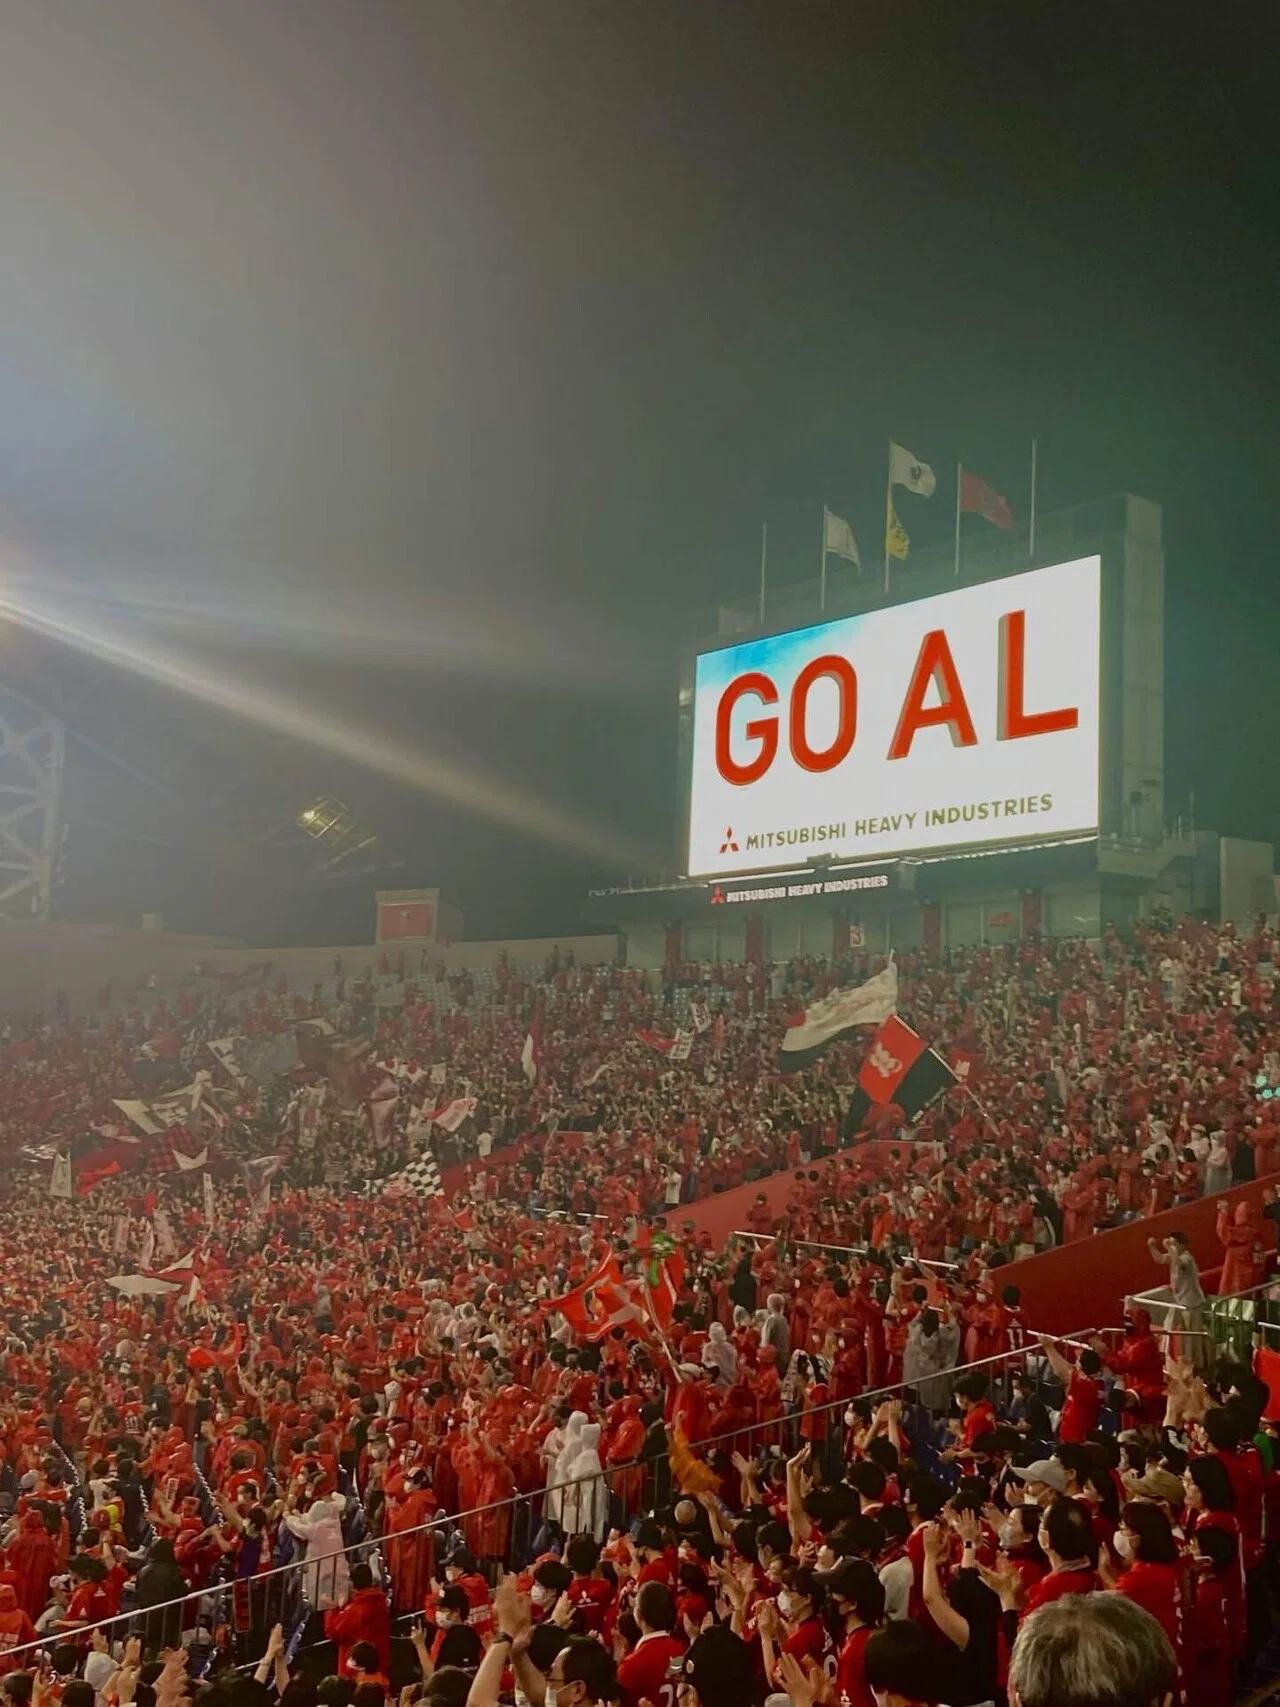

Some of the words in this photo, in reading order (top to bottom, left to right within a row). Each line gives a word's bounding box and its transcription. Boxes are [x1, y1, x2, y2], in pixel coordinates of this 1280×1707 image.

[714, 608, 1079, 786] GOAL
[746, 822, 846, 851] MITSUBISHI
[854, 812, 917, 836] HEAVY
[924, 793, 1053, 828] INDUSTRIES
[726, 886, 787, 903] MITSUBISHI
[788, 882, 823, 897] HEAVY
[824, 875, 889, 893] INDUSTRIES
